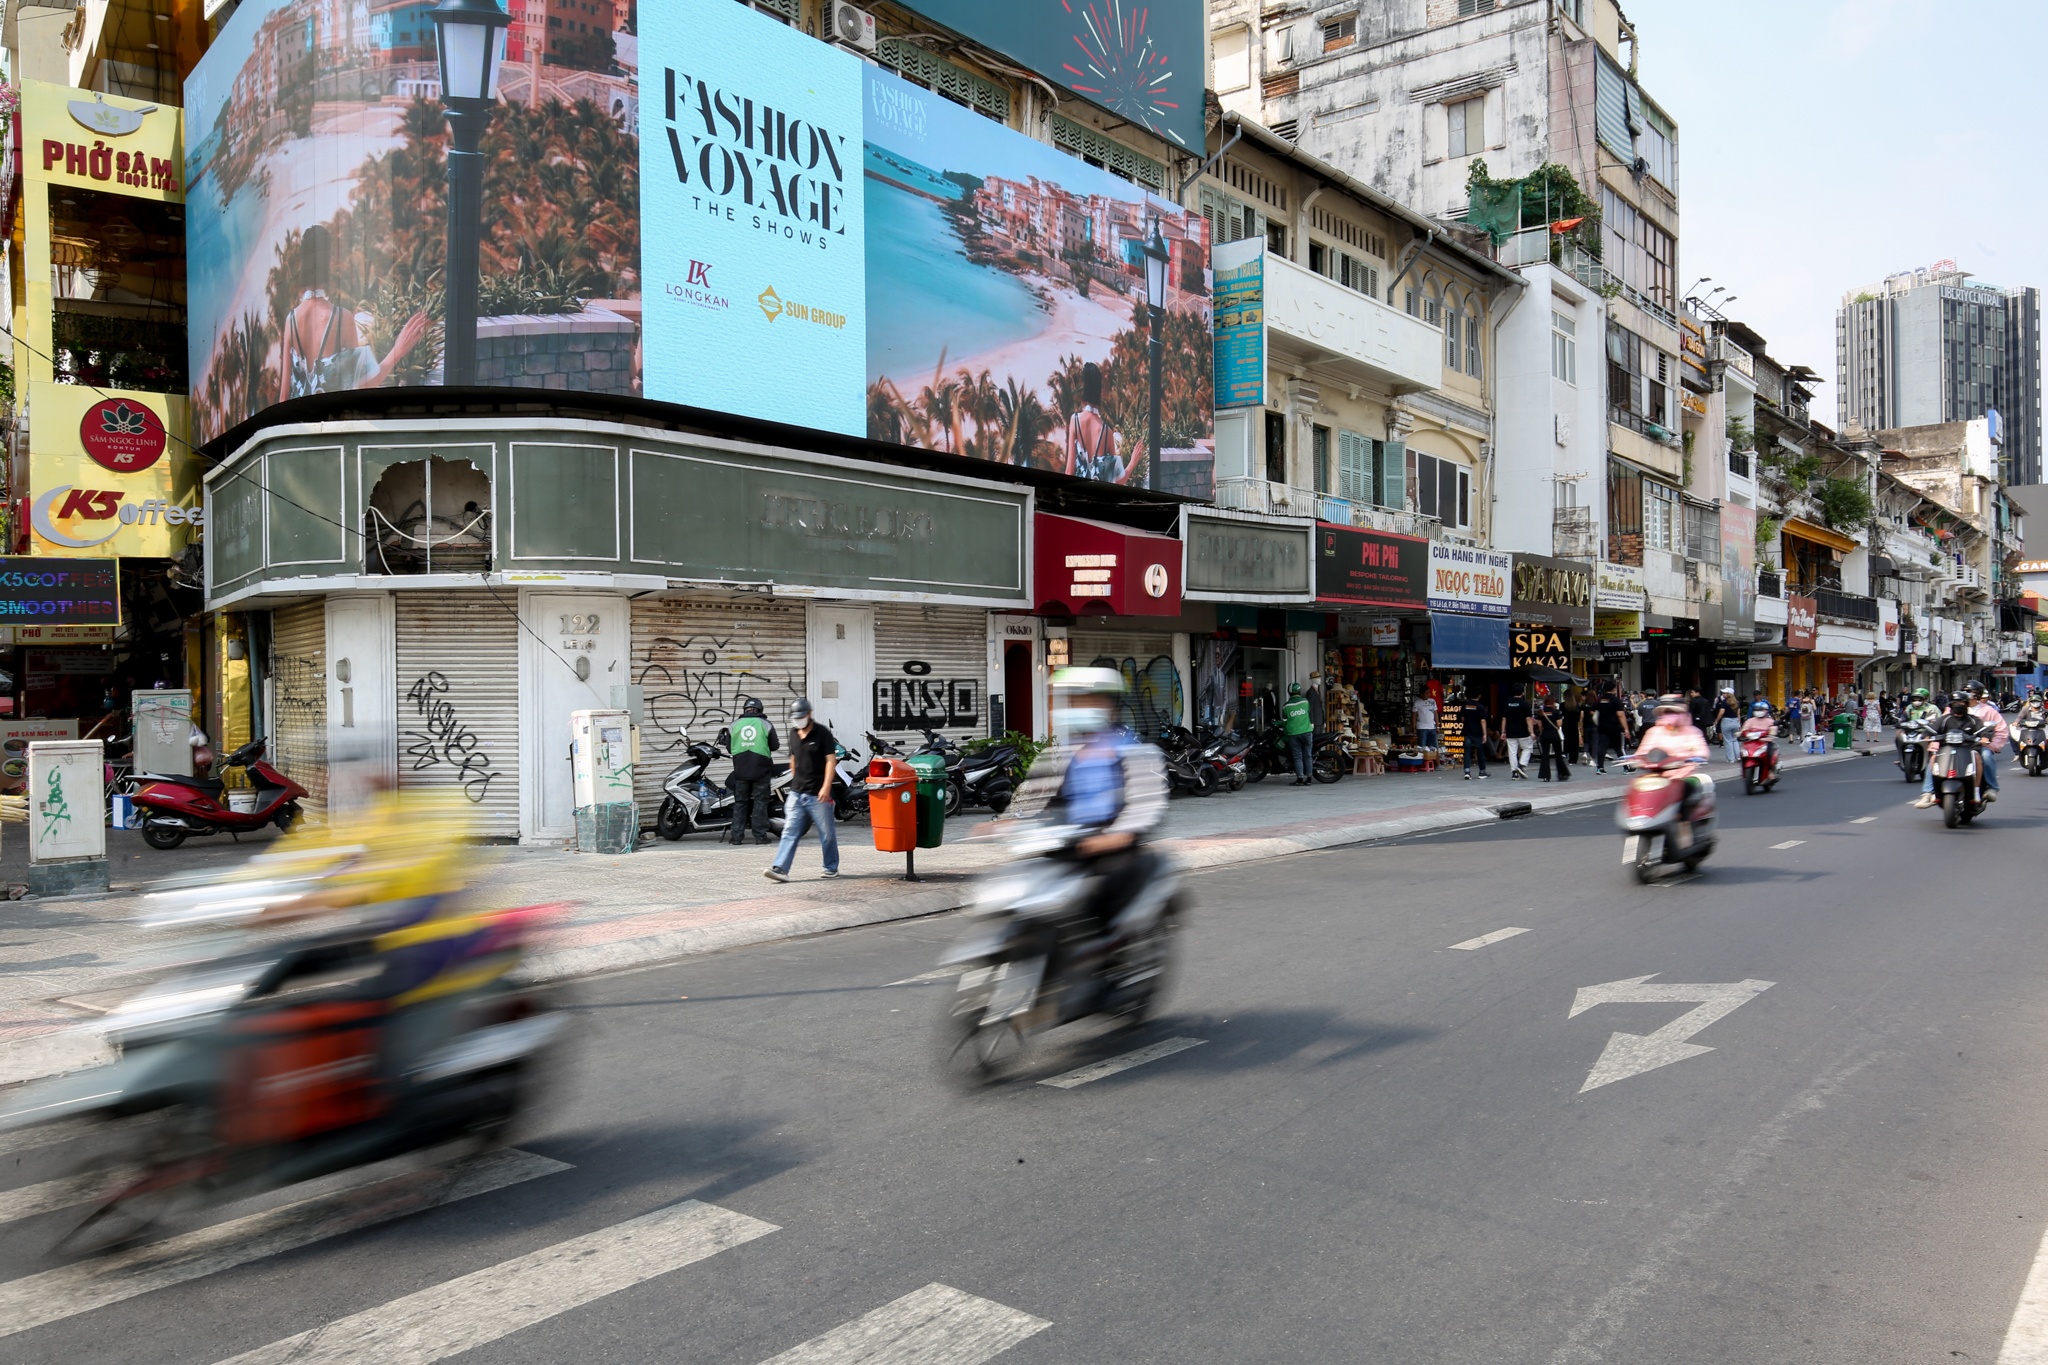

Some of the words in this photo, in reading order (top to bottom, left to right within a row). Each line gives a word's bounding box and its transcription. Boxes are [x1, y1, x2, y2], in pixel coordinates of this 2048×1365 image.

[871, 78, 927, 119] FASHION
[664, 66, 846, 182] FASHION
[872, 96, 927, 136] VOYAGE
[43, 139, 113, 180] PHỞ
[116, 151, 172, 179] SÂM
[117, 171, 148, 188] NGỌC
[665, 125, 845, 235] VOYAGE
[692, 196, 735, 221] THE
[752, 215, 827, 250] SHOWS
[1240, 261, 1261, 278] TRAVEL
[666, 283, 729, 308] LONGKAN
[1231, 280, 1260, 291] SERVICE
[1940, 285, 1968, 302] LIBERTY
[1968, 291, 2001, 308] CENTRAL
[785, 301, 809, 320] SUN
[811, 307, 846, 329] GROUP
[136, 438, 157, 447] LINH
[113, 453, 135, 463] K5
[57, 489, 125, 520] K5
[1432, 544, 1450, 560] CỬA
[1452, 547, 1474, 563] HÀNG
[1475, 551, 1487, 565] MỸ
[1488, 555, 1508, 571] NGHỆ
[1349, 570, 1378, 579] BESPOKE
[1379, 573, 1409, 583] TAILORING
[1435, 568, 1470, 598] NGỌC
[1473, 568, 1505, 598] THẢO
[1514, 561, 1546, 603] SPA
[1548, 568, 1590, 607] KAKA
[22, 627, 42, 638] PHỞ
[559, 614, 601, 635] 122
[1515, 632, 1565, 654] SPA
[1714, 657, 1727, 666] XQ
[1290, 708, 1306, 717] Grab
